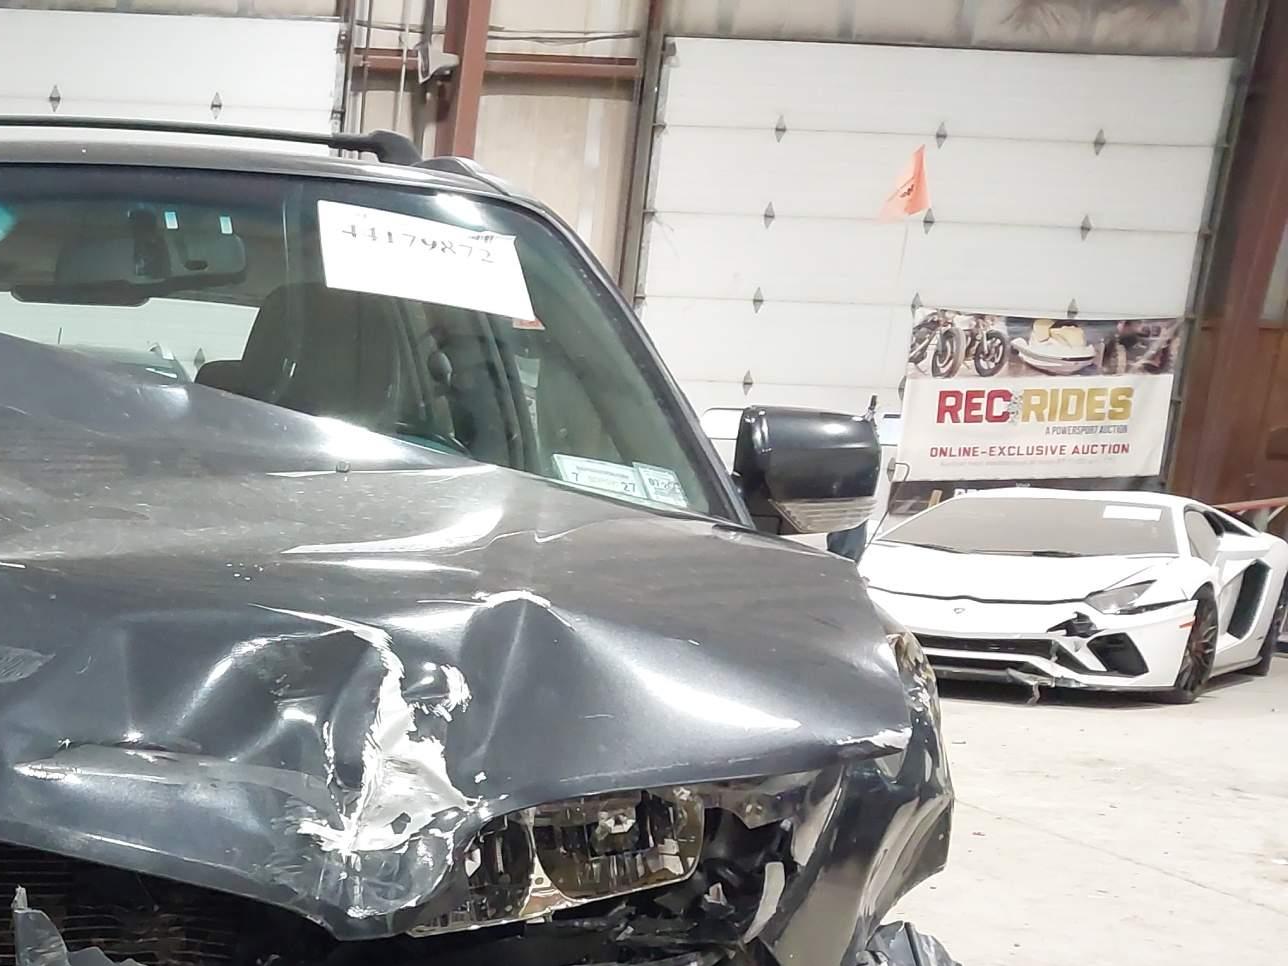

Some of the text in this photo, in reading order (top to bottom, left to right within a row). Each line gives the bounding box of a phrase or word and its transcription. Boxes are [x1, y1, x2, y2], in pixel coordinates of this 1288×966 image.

[936, 387, 1134, 424] REC RIDES
[929, 443, 1130, 458] ONLINE-EXCLUSIVE AUCTION
